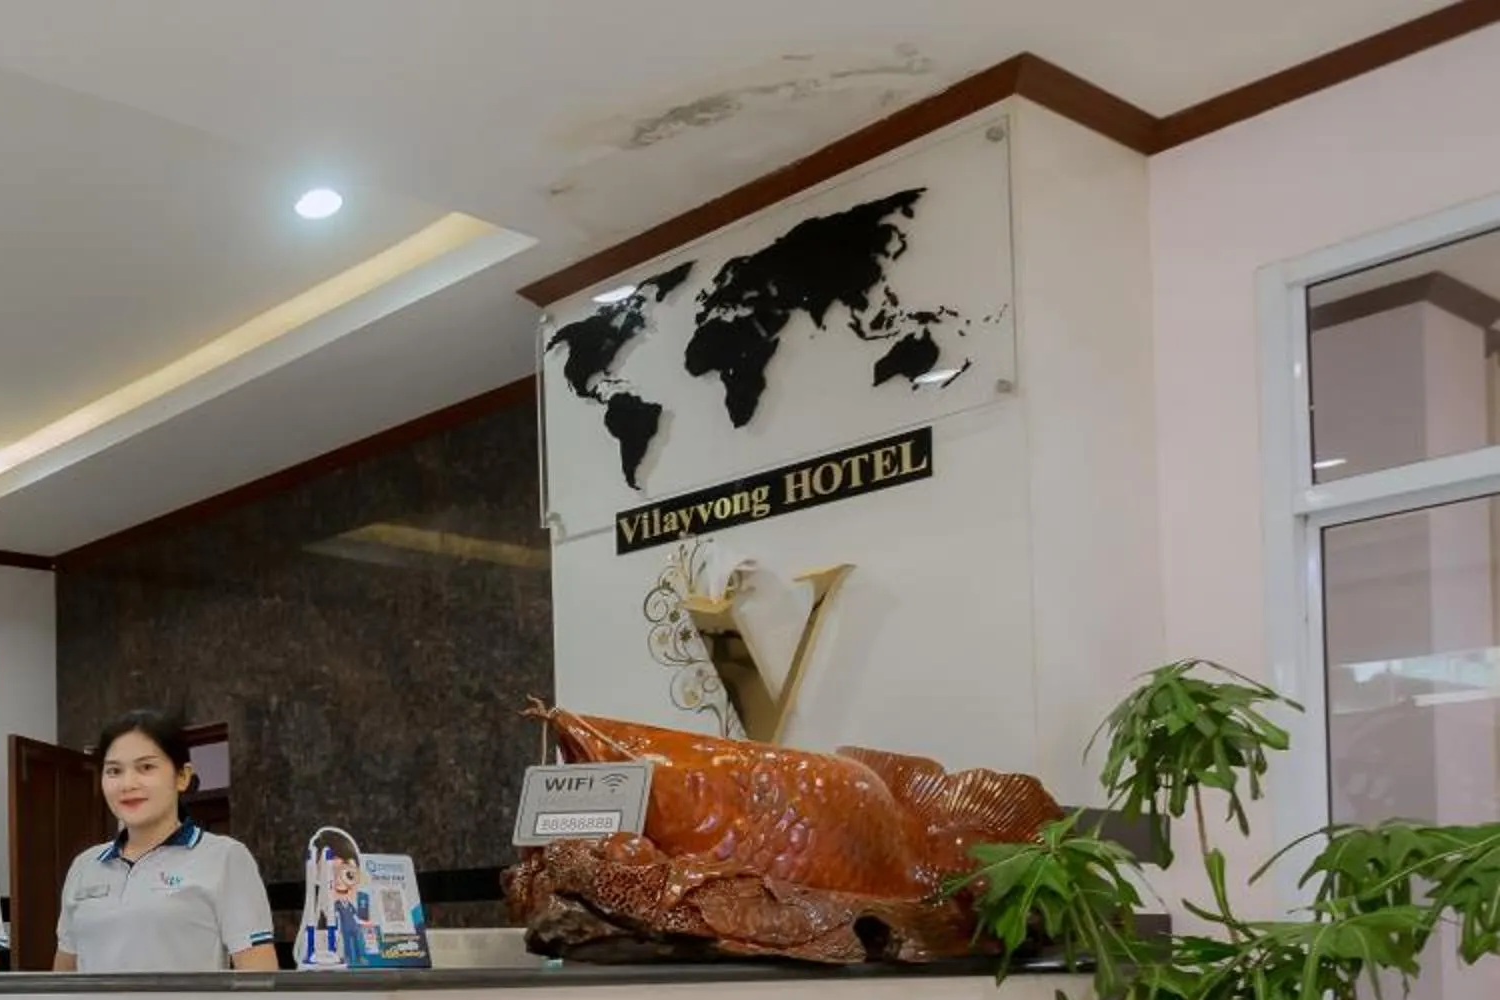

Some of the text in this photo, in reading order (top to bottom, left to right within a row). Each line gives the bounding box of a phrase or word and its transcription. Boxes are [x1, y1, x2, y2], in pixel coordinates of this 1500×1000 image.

[618, 439, 927, 544] Vilayvong HOTEL
[545, 775, 594, 792] WIFI
